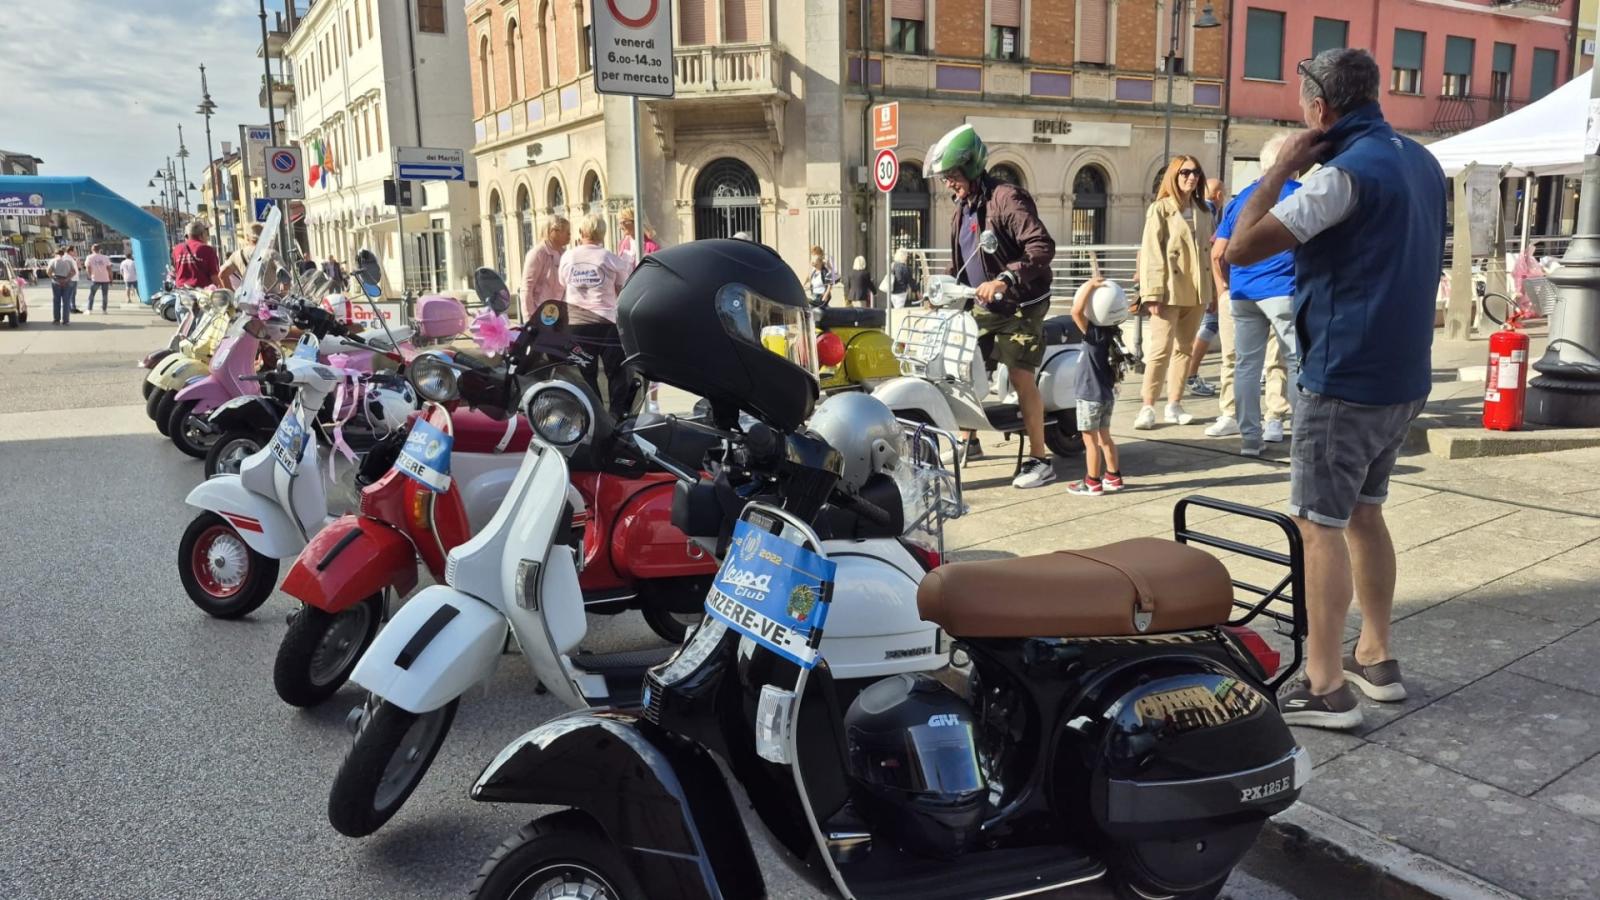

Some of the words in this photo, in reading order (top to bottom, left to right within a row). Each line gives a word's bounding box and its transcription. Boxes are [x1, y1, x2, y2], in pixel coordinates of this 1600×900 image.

[602, 71, 620, 81] per
[623, 72, 669, 85] mercato
[880, 161, 893, 180] 30
[758, 549, 783, 566] 2022
[715, 554, 773, 594] Vespa
[734, 586, 766, 602] Club
[927, 713, 960, 727] GIVI
